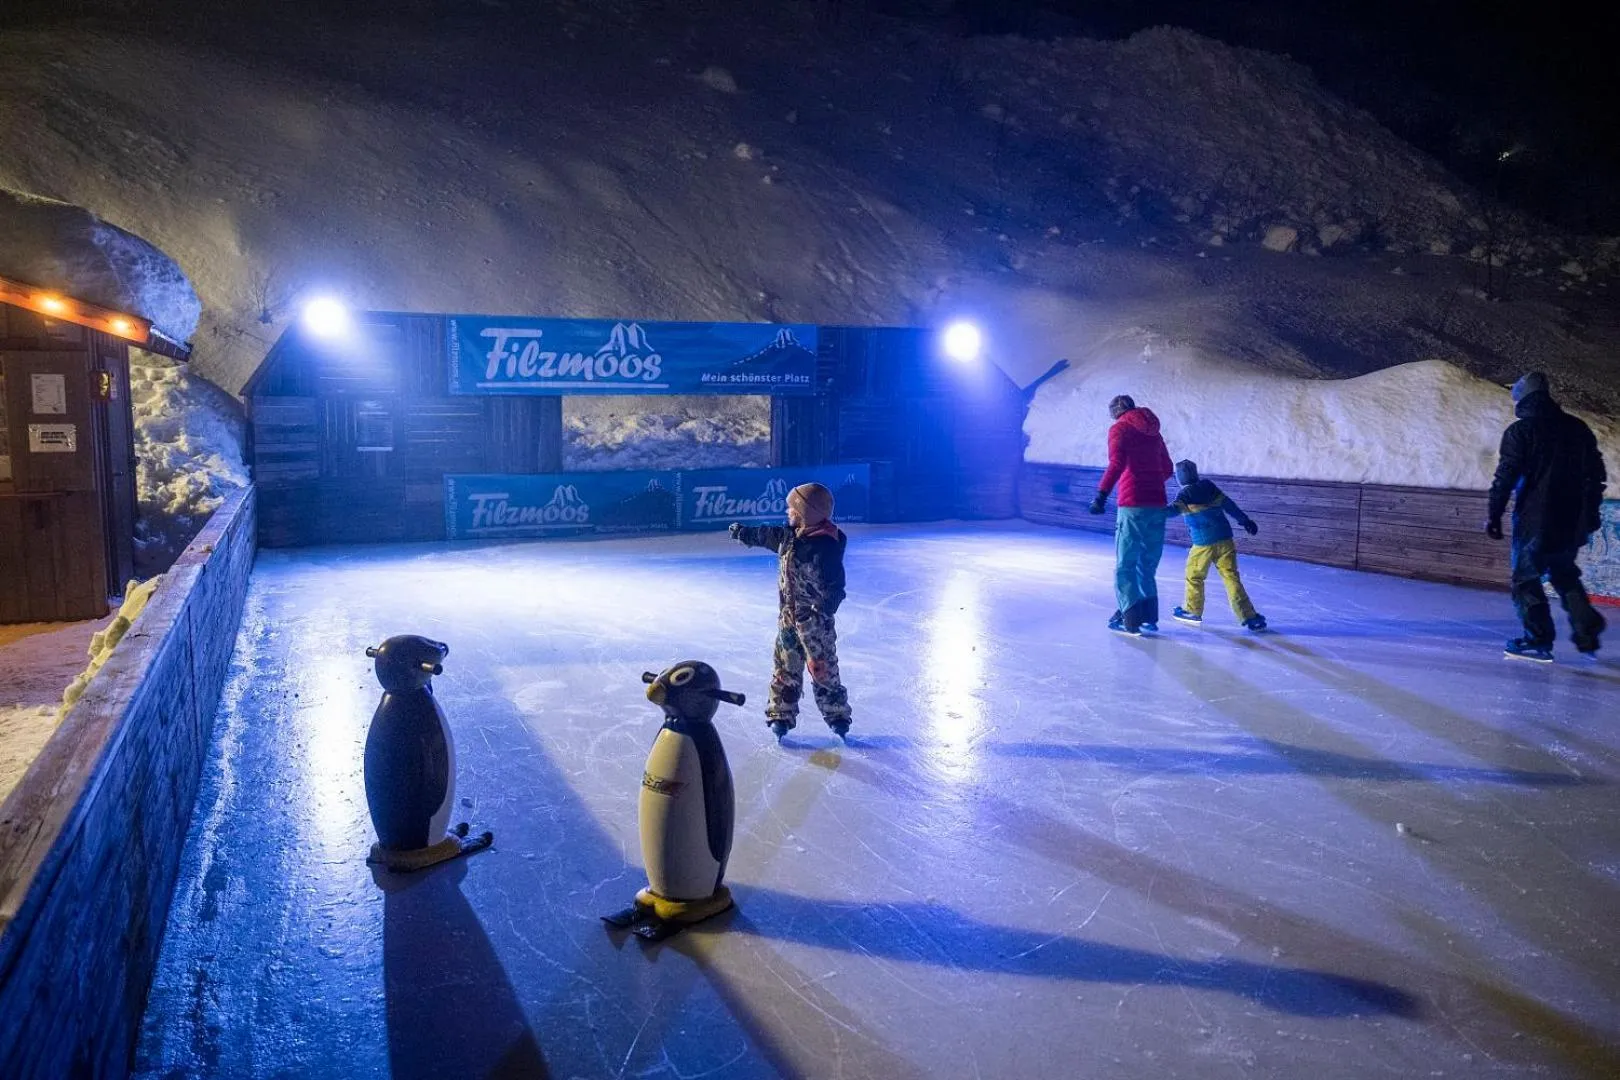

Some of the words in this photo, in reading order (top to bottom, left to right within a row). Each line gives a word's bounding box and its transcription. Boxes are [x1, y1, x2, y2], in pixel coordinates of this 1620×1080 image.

[480, 327, 662, 381] Filzmoos
[701, 372, 728, 384] Mein
[731, 372, 782, 384] schönster
[784, 373, 810, 384] Platz
[468, 492, 590, 528] Filzmoos
[692, 485, 788, 518] Filzmoo
